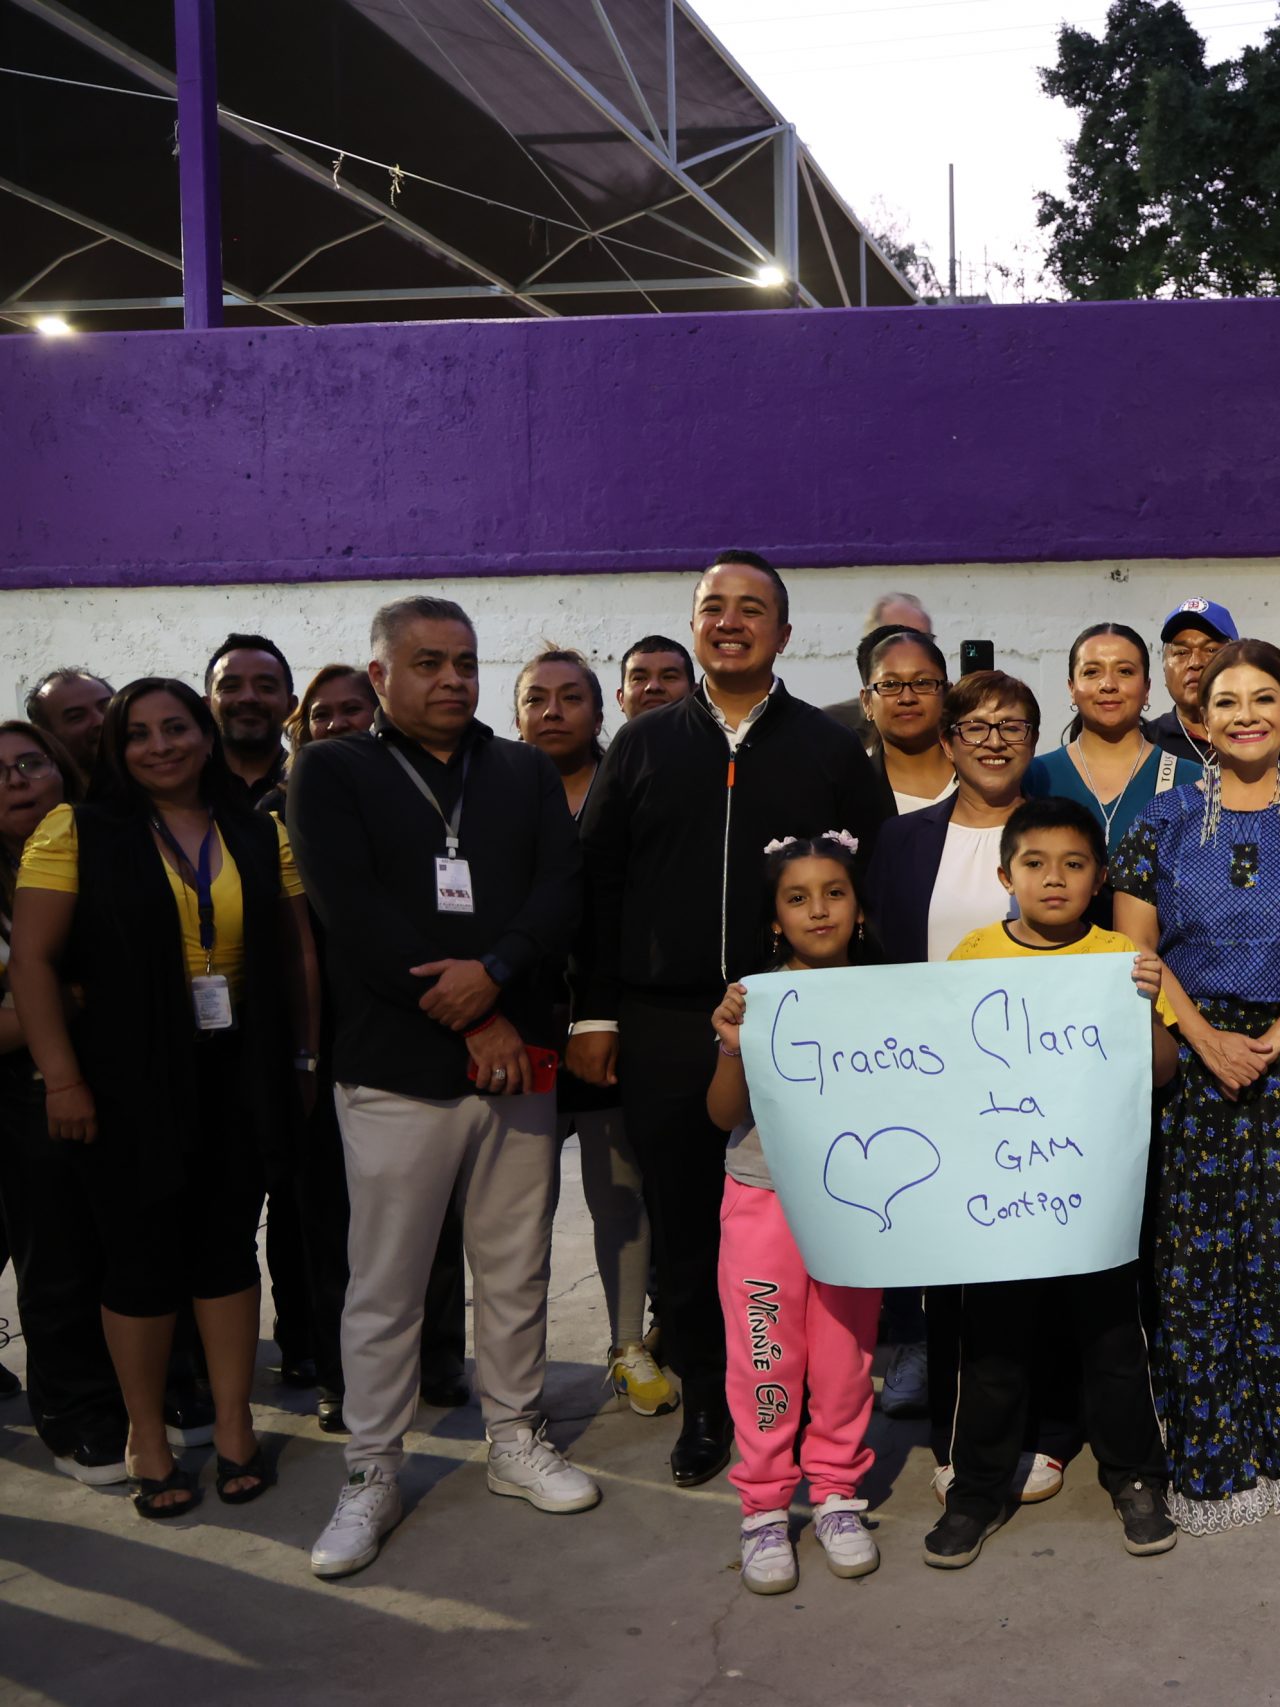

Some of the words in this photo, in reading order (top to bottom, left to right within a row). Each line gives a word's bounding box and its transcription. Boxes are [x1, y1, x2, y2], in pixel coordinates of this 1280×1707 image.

[1161, 755, 1174, 783] TOUS
[771, 989, 944, 1095] Gracias
[971, 988, 1107, 1069] Clara
[995, 1137, 1083, 1172] GAM
[967, 1192, 1081, 1226] Contigo
